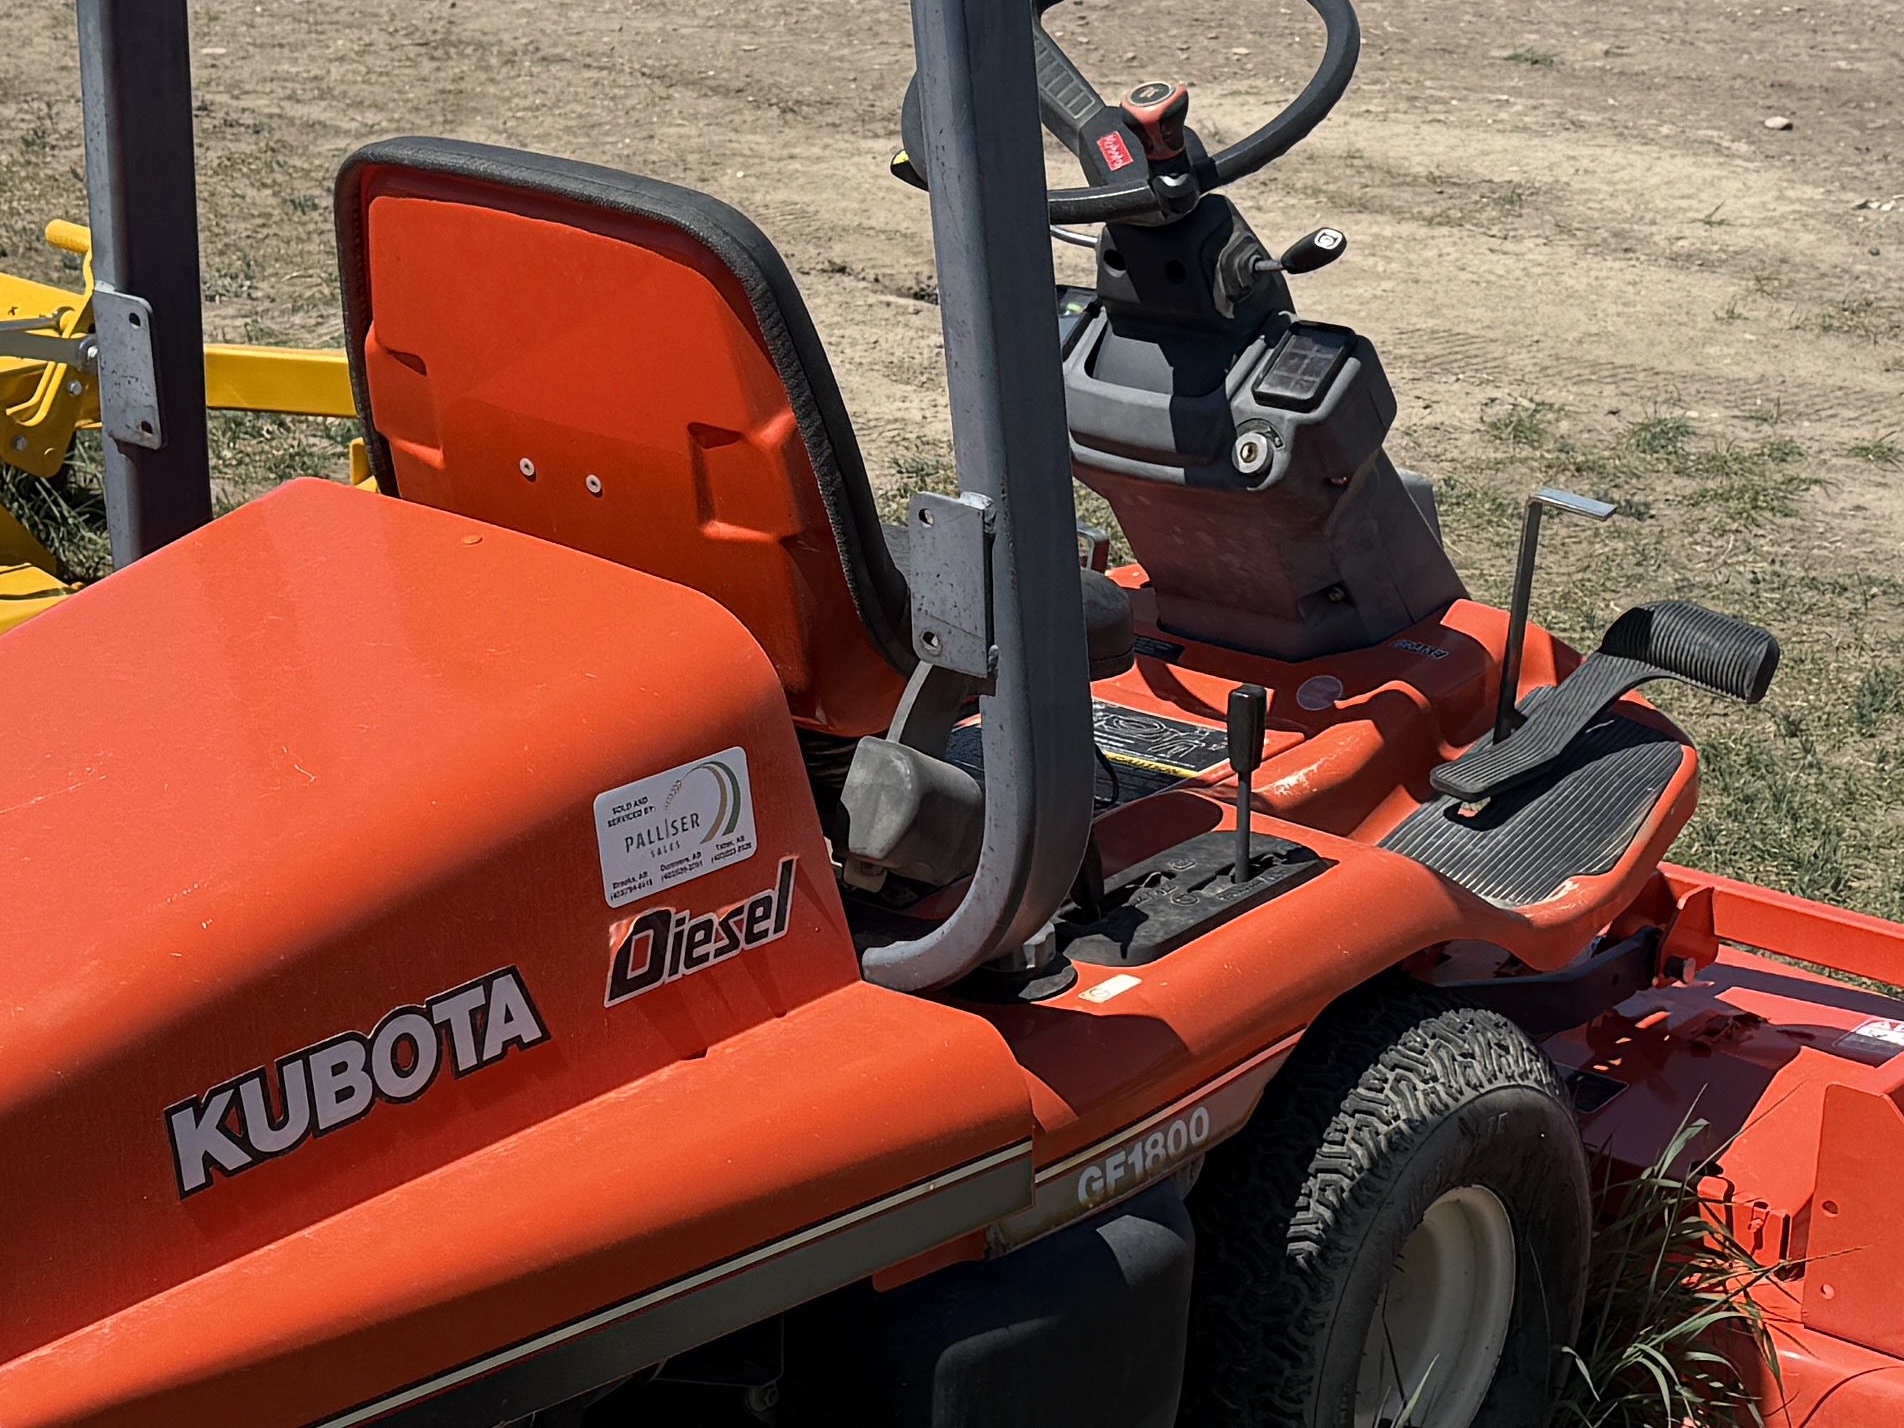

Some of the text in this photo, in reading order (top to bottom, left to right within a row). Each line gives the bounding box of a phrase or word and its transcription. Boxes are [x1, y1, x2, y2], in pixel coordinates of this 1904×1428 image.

[625, 812, 701, 853] PALLISER
[650, 840, 681, 859] SALES
[606, 857, 796, 1004] Diesel
[168, 969, 546, 1195] KUBOTA
[1078, 1106, 1210, 1208] GF1800
